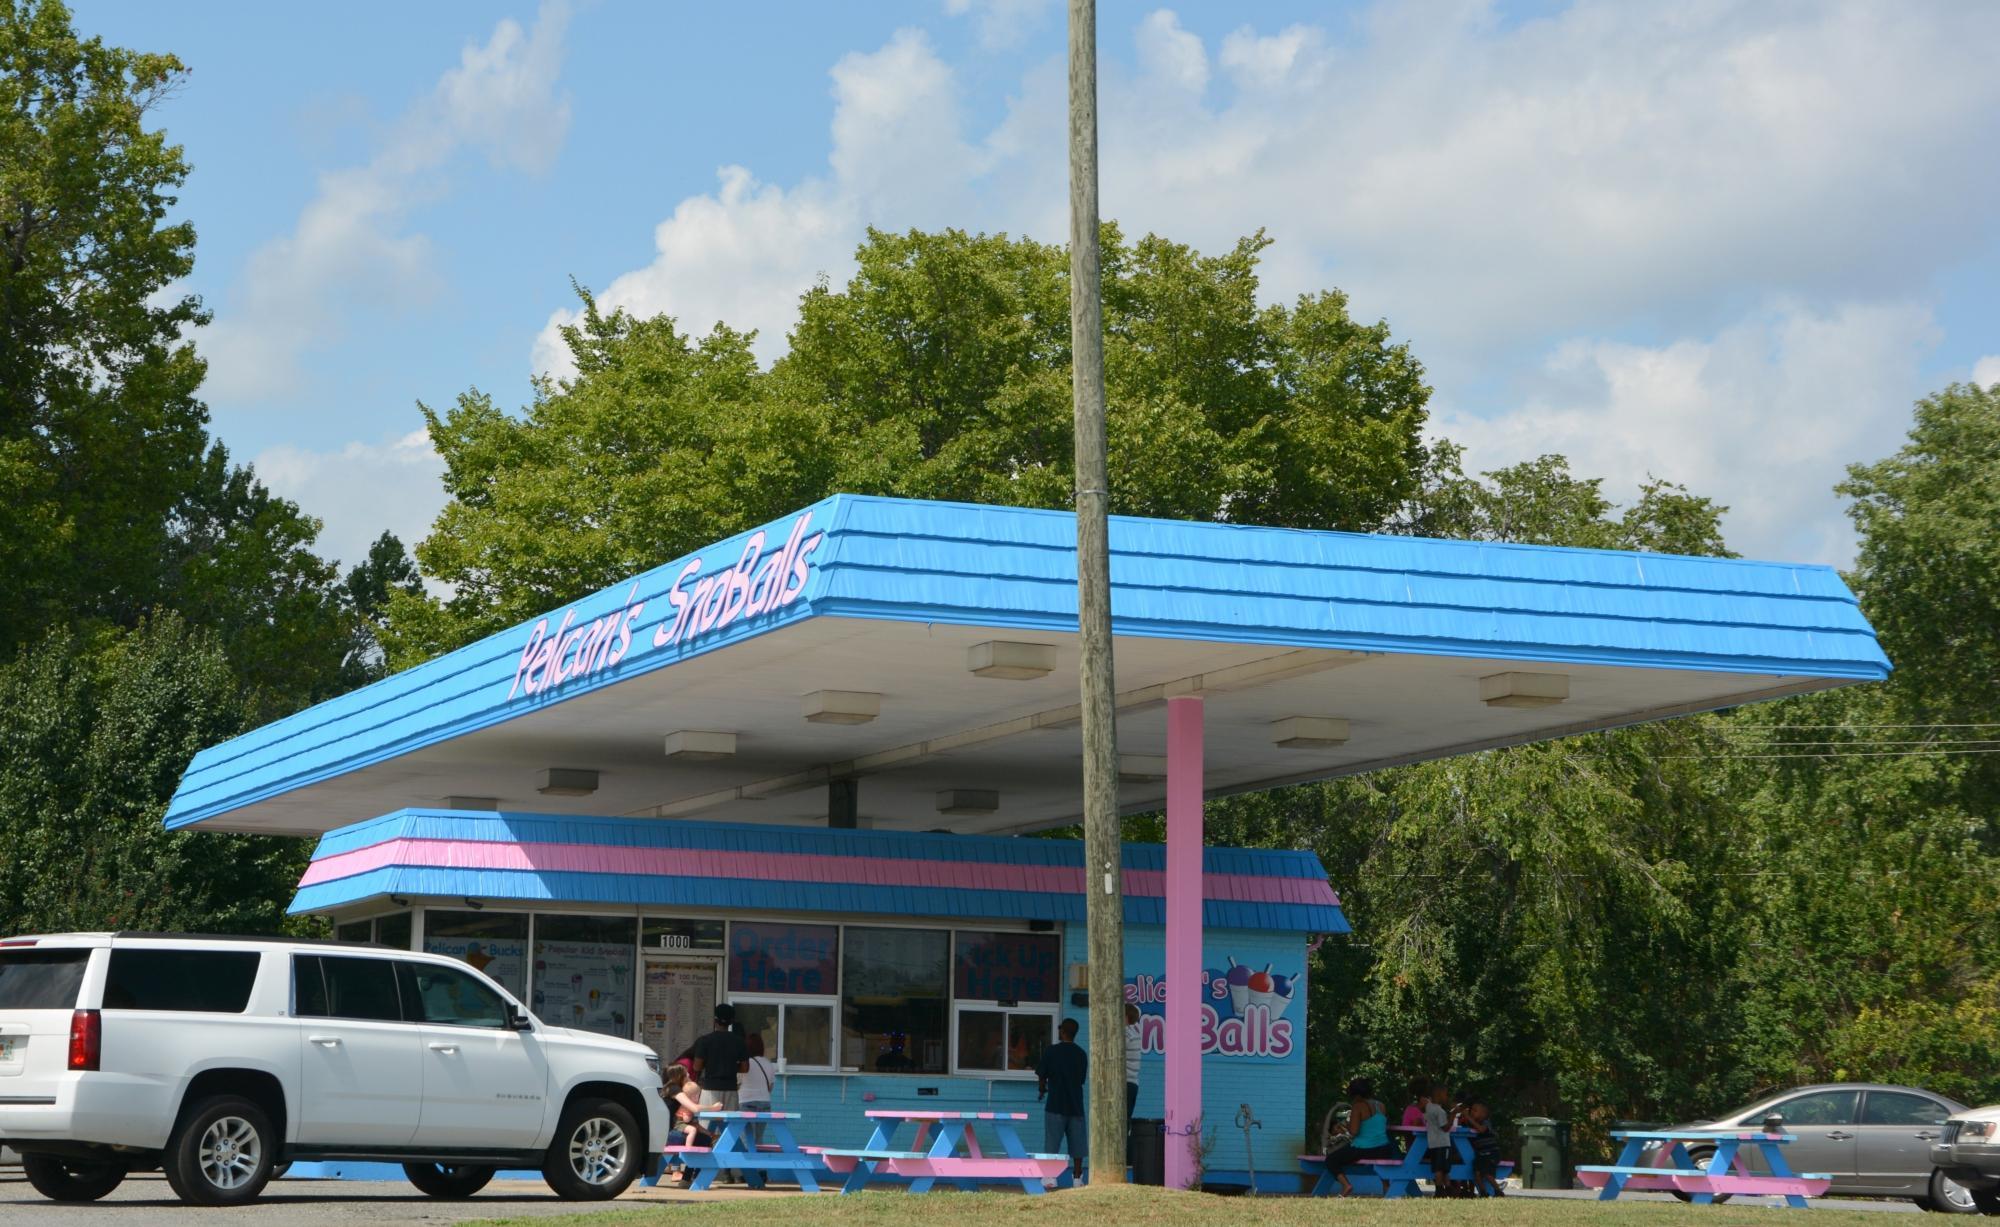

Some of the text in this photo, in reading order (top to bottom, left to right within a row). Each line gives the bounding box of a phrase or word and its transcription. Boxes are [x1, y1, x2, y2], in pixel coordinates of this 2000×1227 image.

[507, 510, 824, 701] Pelican's SnoBalls
[489, 943, 525, 956] Bucks
[662, 936, 688, 948] 1000
[734, 927, 829, 960] Order
[742, 960, 822, 992] Here
[967, 968, 1043, 999] Here
